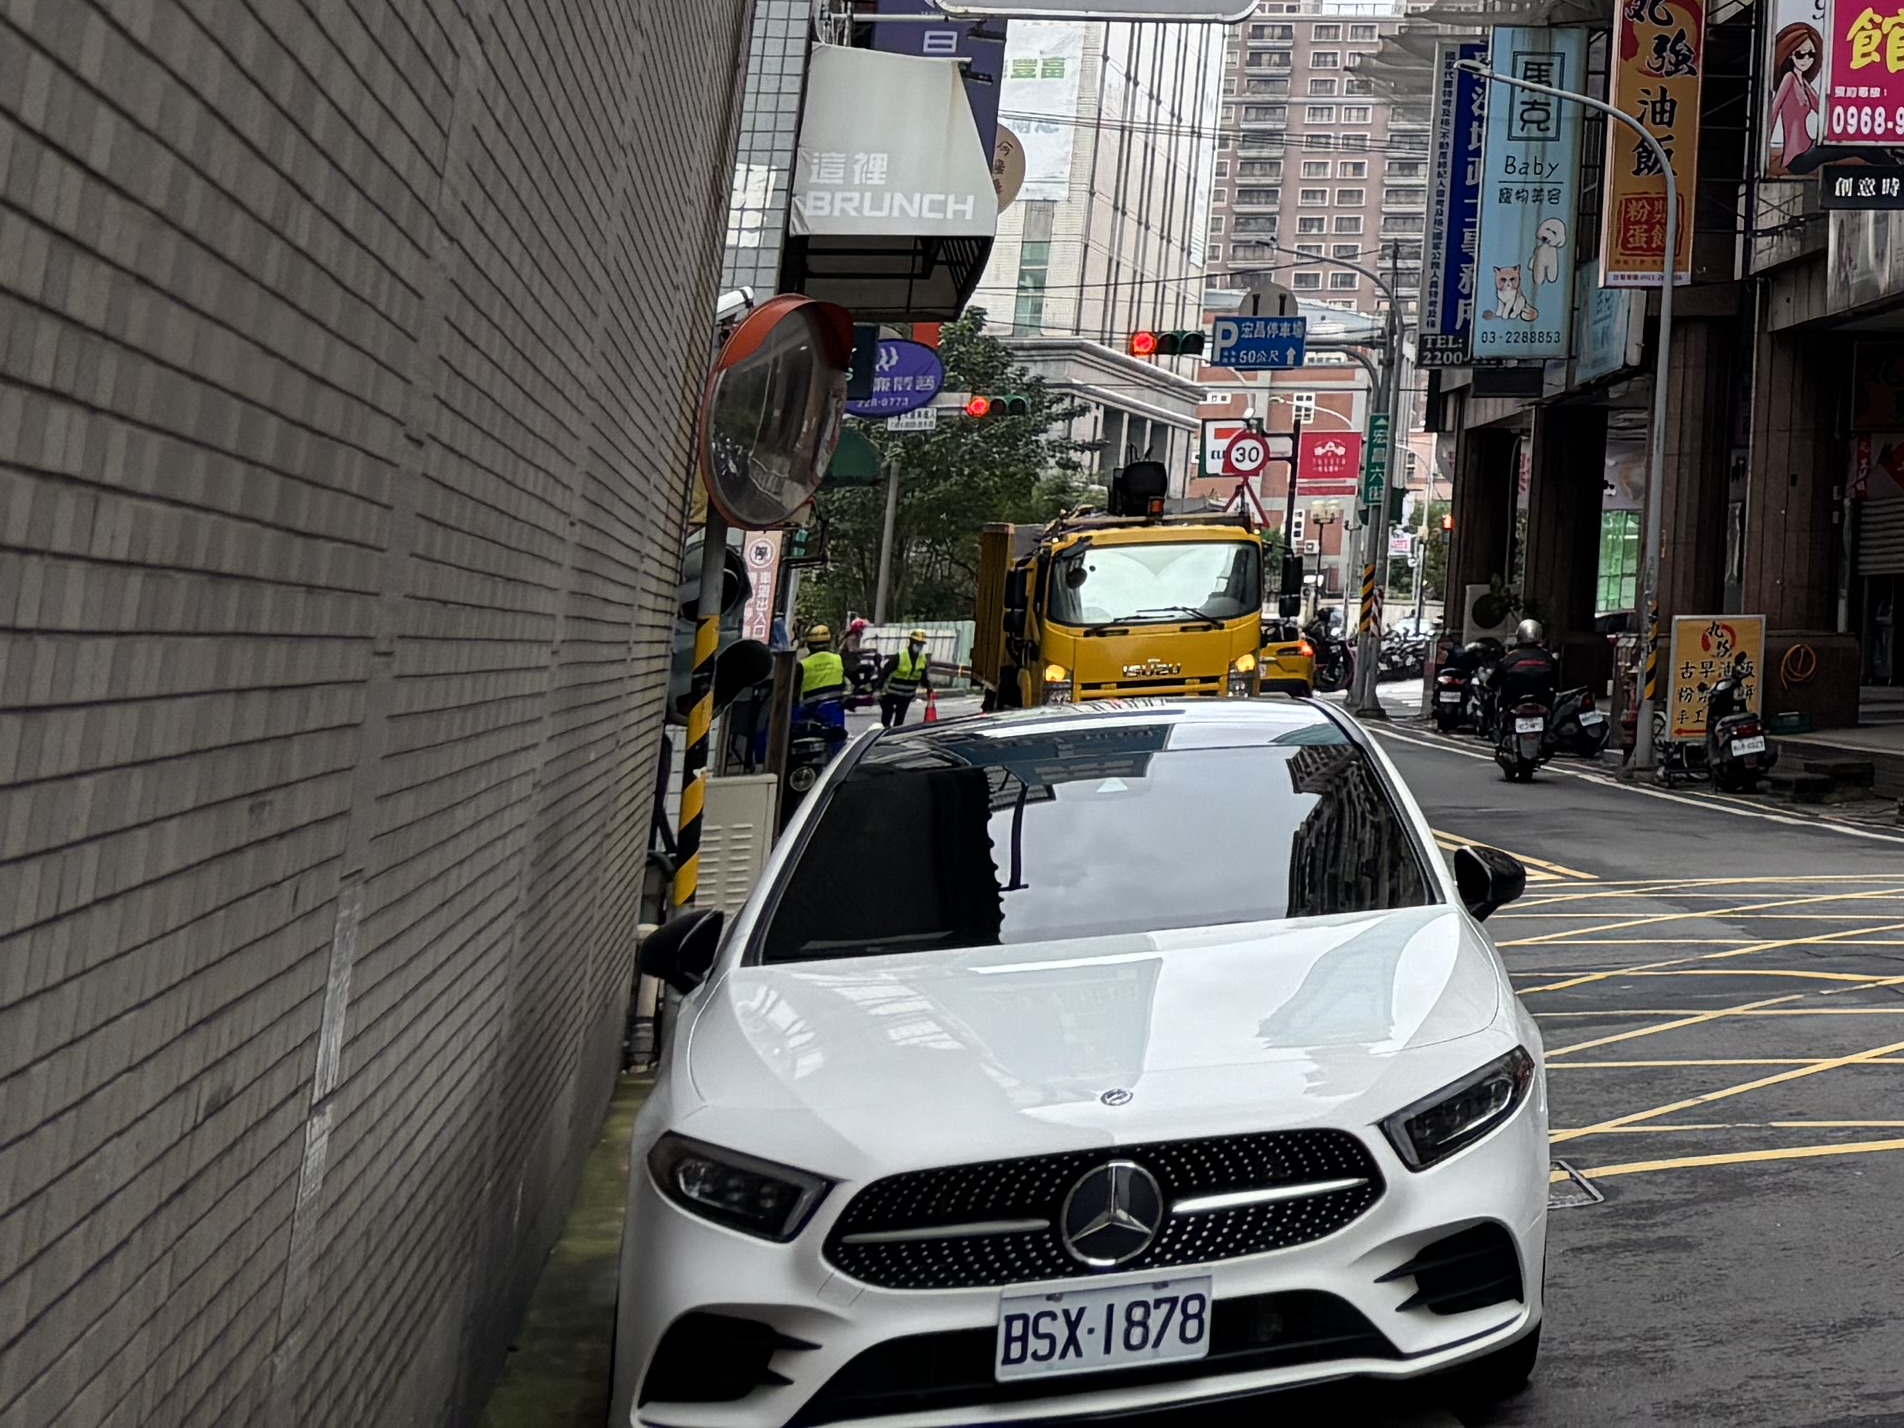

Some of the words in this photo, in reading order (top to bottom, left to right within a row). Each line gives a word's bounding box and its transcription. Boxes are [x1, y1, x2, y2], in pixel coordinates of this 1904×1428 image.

[809, 152, 889, 186] 這裡
[1504, 155, 1560, 180] Baby
[805, 190, 975, 221] BRUNCH
[1213, 321, 1239, 361] P
[1480, 330, 1561, 344] 03-2288853
[1235, 446, 1259, 463] 30
[1123, 663, 1180, 677] ISUZU
